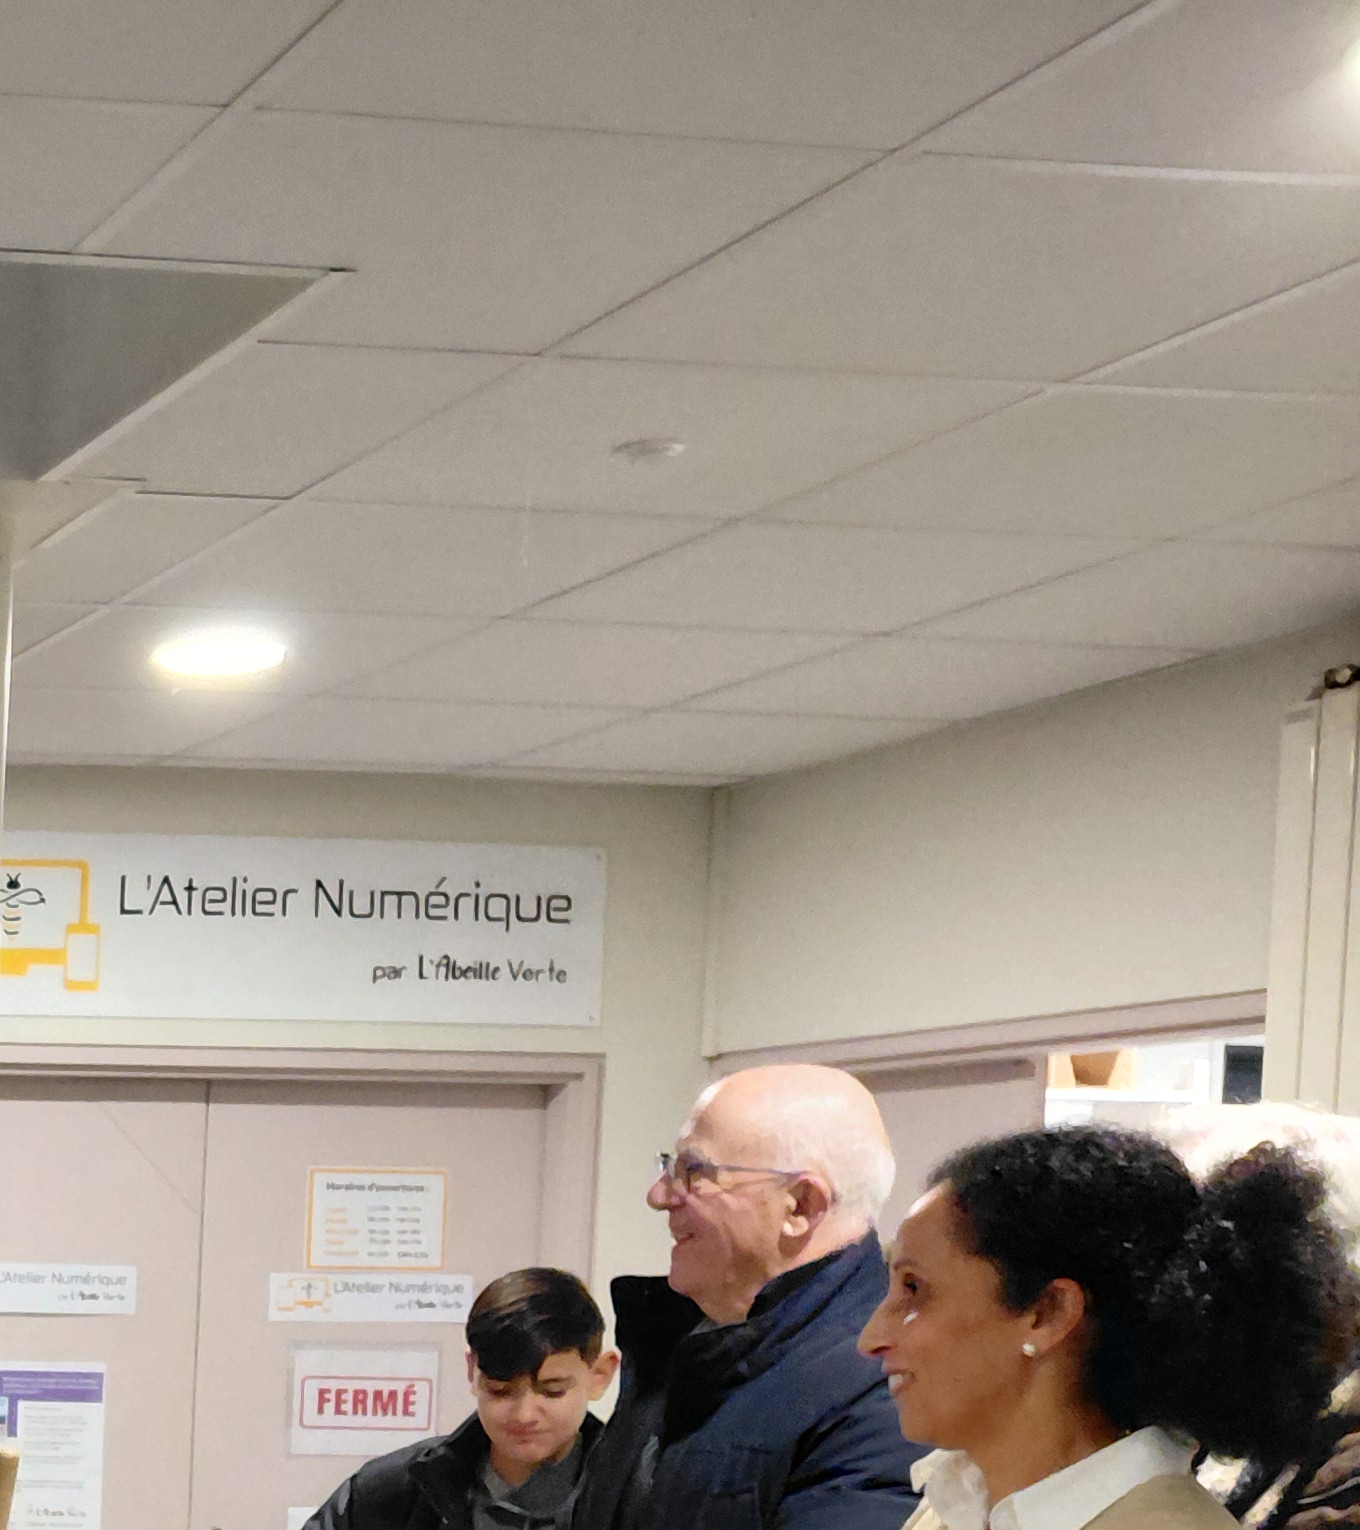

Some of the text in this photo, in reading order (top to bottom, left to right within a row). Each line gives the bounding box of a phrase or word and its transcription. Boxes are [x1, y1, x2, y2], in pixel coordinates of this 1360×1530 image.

[119, 874, 573, 932] L'Atelier Numérique
[372, 964, 408, 984] par
[418, 954, 501, 982] L'Abeille
[317, 1384, 417, 1417] FERMÉ
